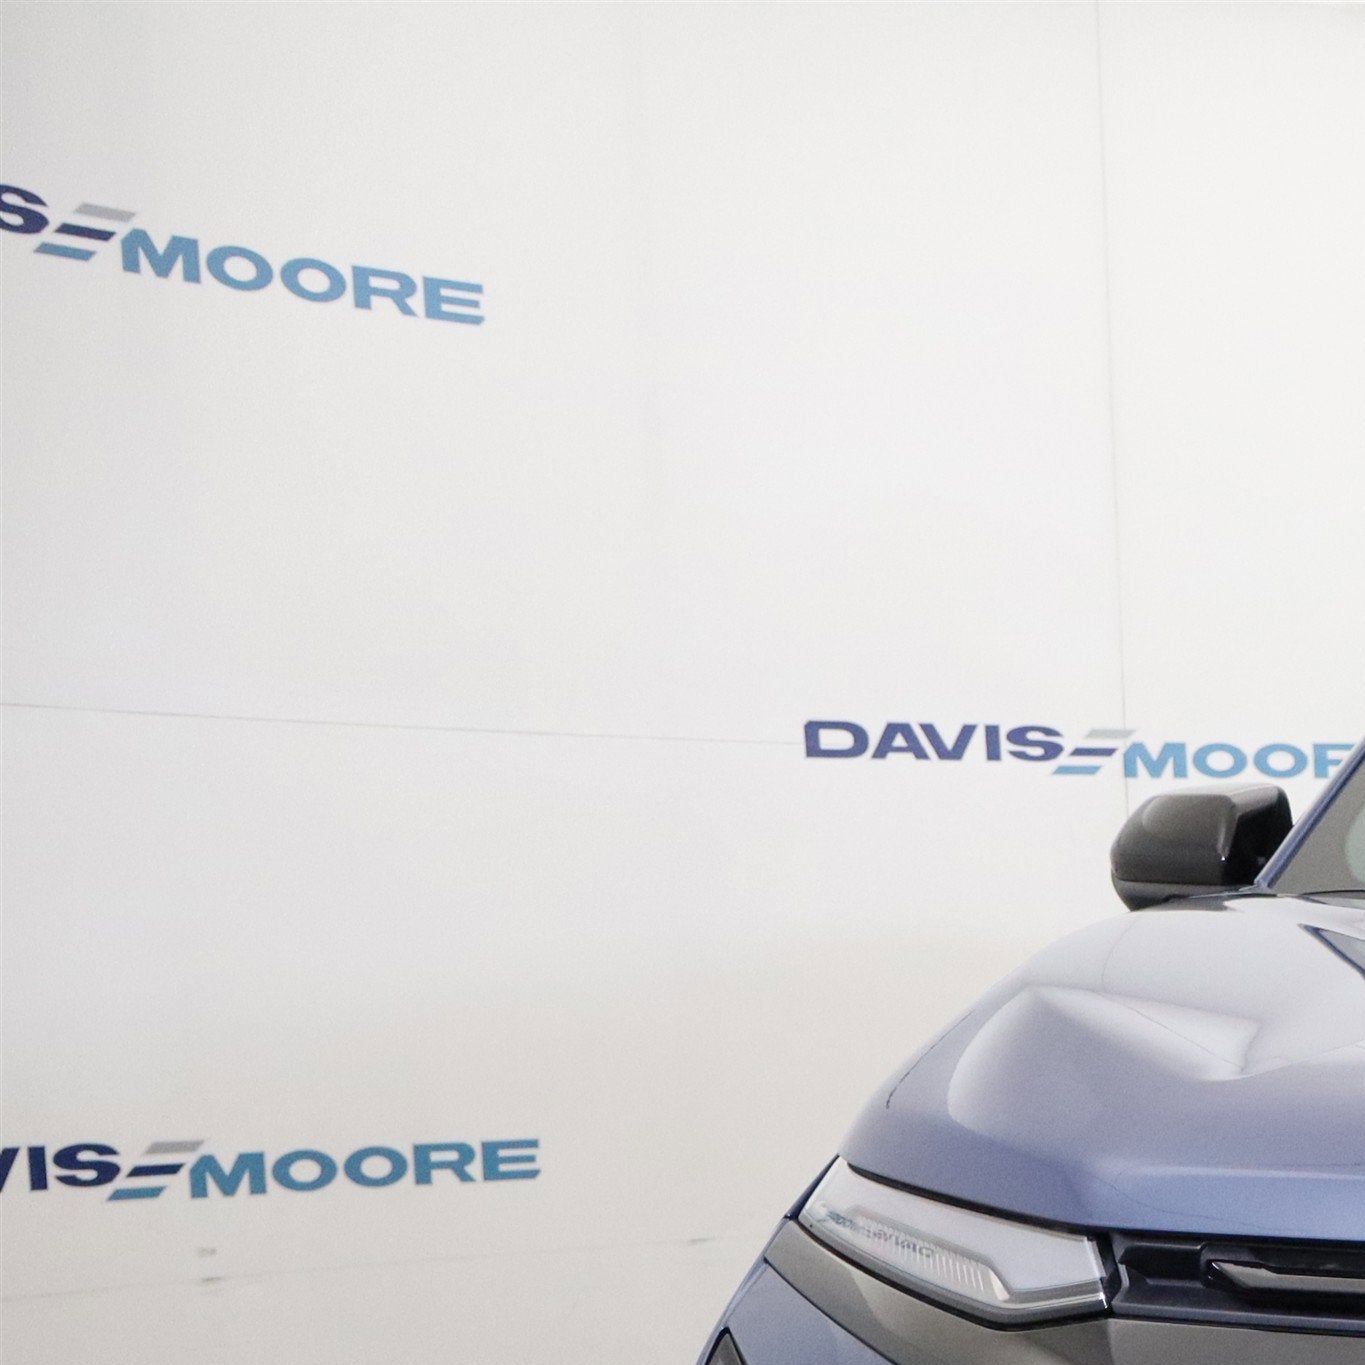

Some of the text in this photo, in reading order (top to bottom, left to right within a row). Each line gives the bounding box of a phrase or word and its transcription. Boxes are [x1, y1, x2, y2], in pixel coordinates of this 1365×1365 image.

[119, 227, 485, 326] MOORE
[804, 720, 1064, 762] DAVIS
[189, 1138, 541, 1199] MOORE
